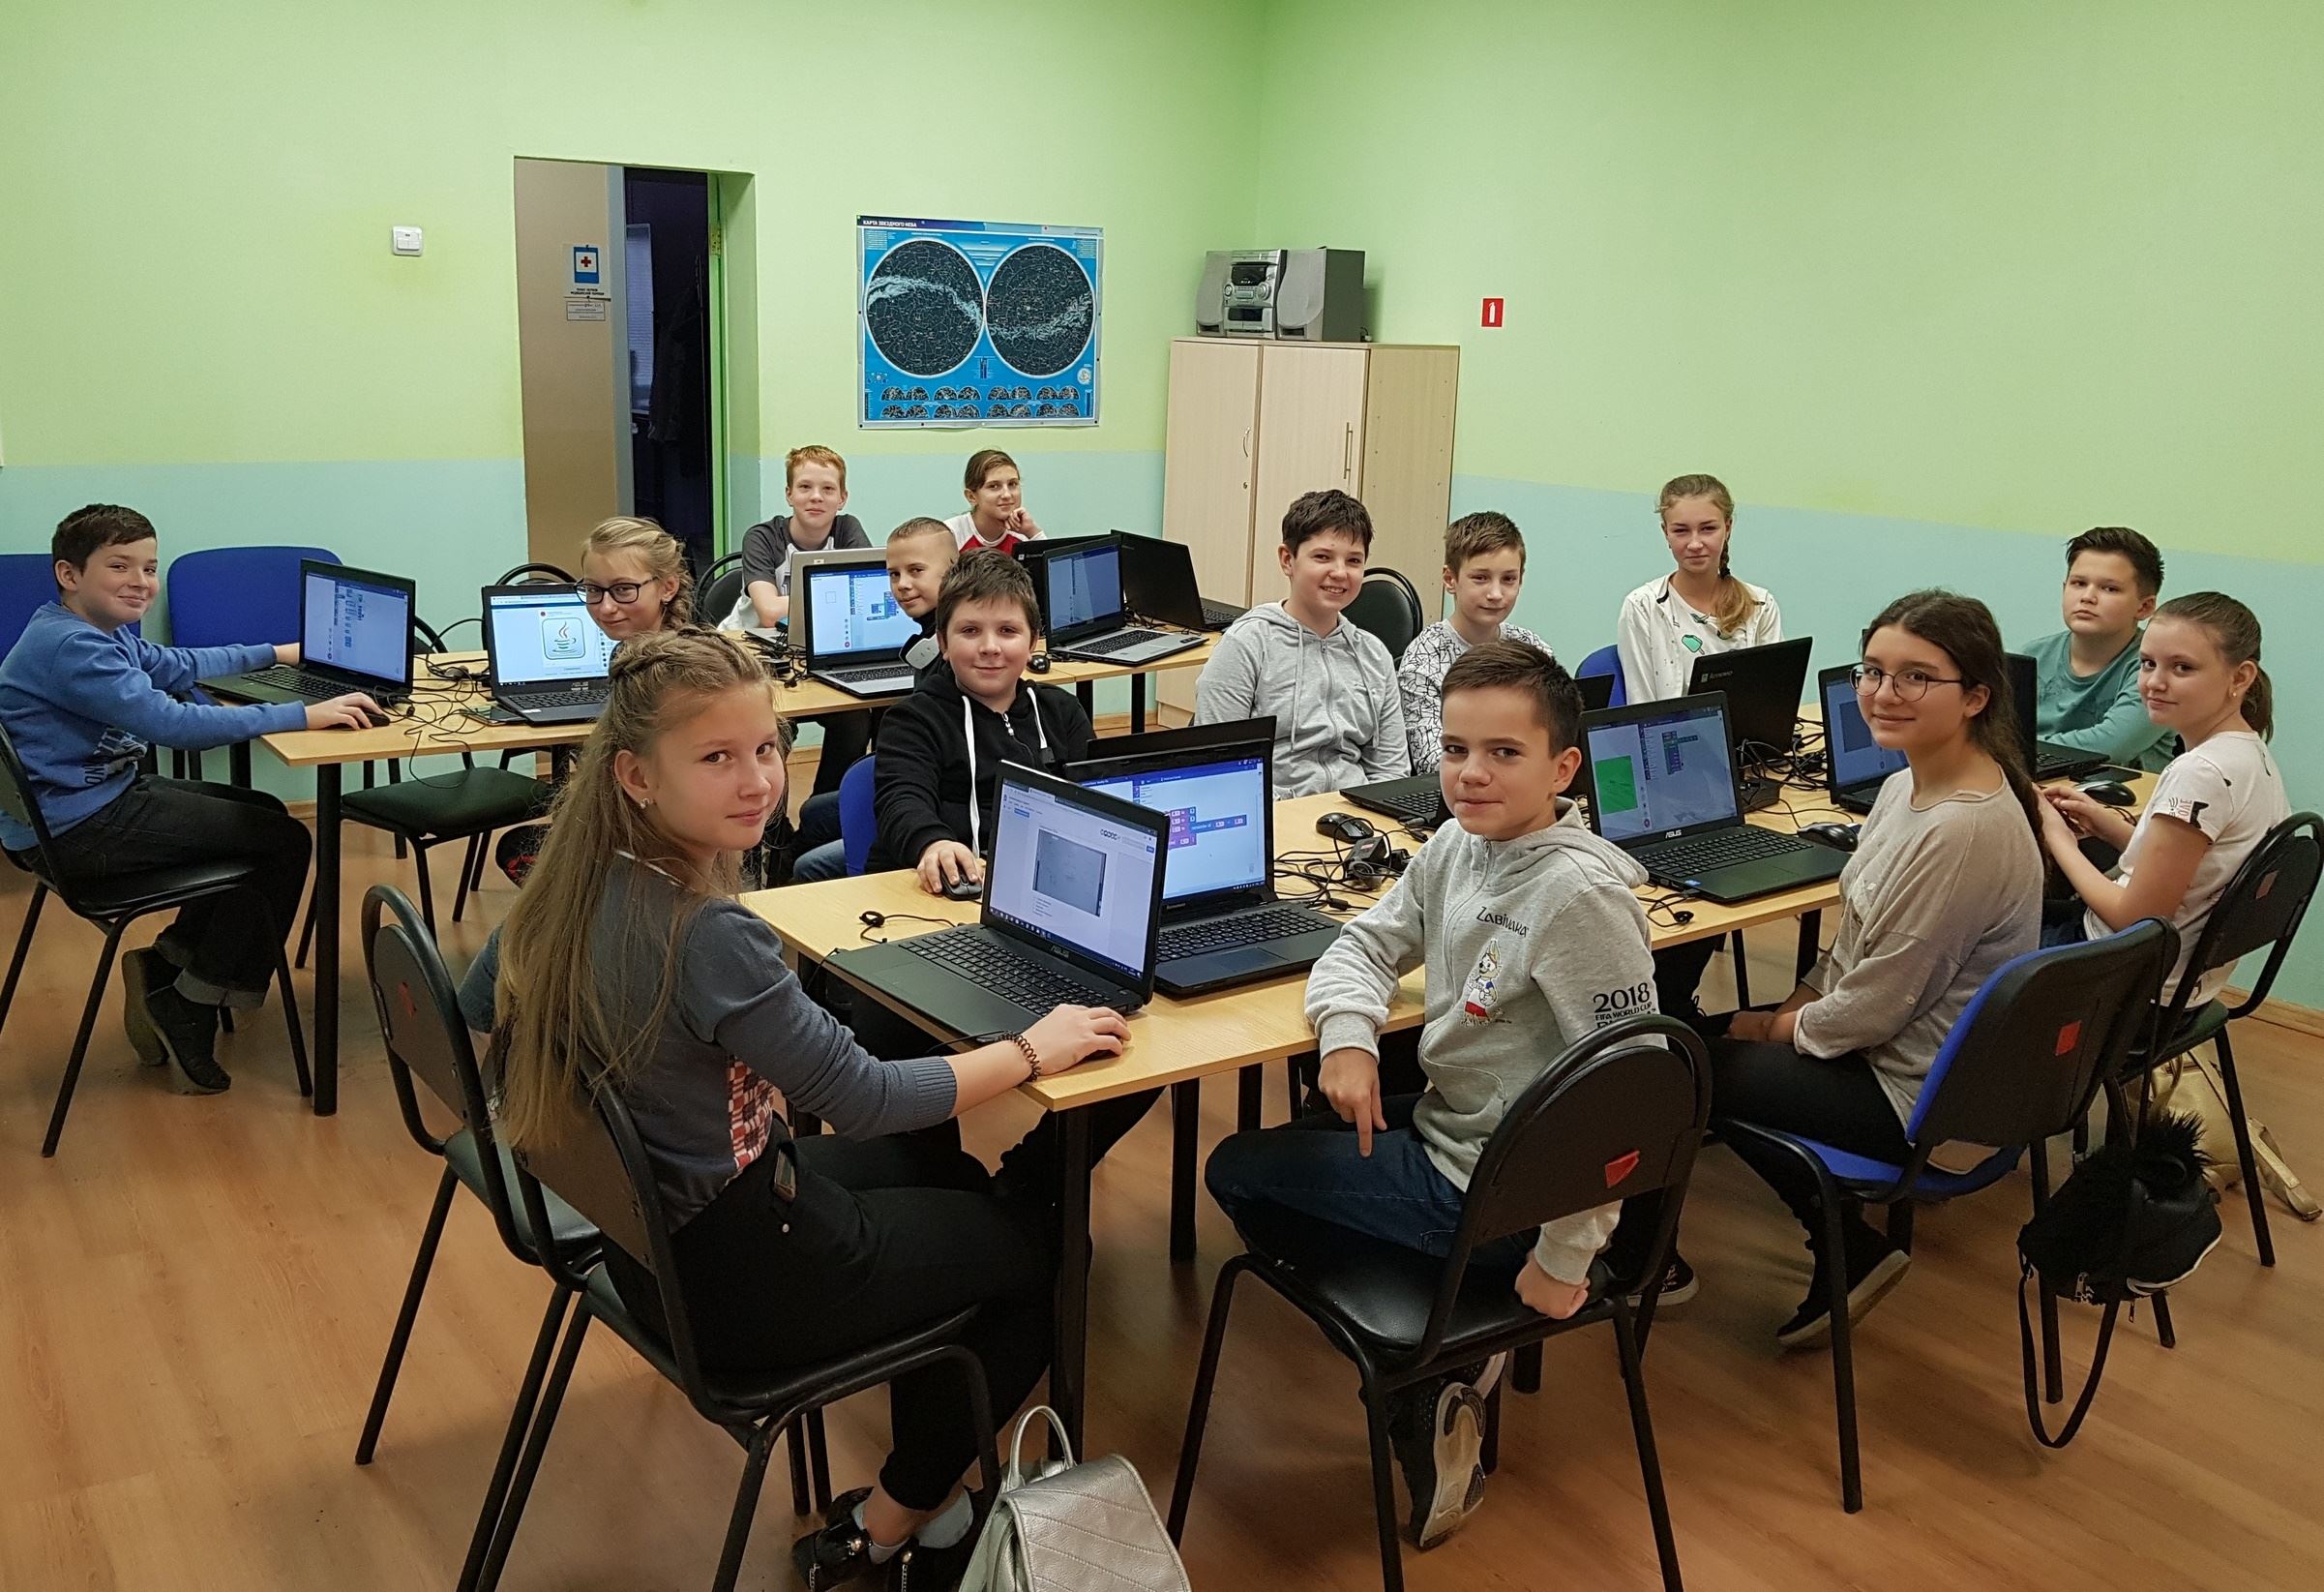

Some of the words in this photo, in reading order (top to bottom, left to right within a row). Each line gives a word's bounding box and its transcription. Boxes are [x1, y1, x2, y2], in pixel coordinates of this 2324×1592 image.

[1665, 829, 1683, 839] ASUS
[1593, 982, 1651, 1013] 2018
[1612, 1006, 1640, 1018] WORLD
[1639, 1001, 1653, 1012] CUP
